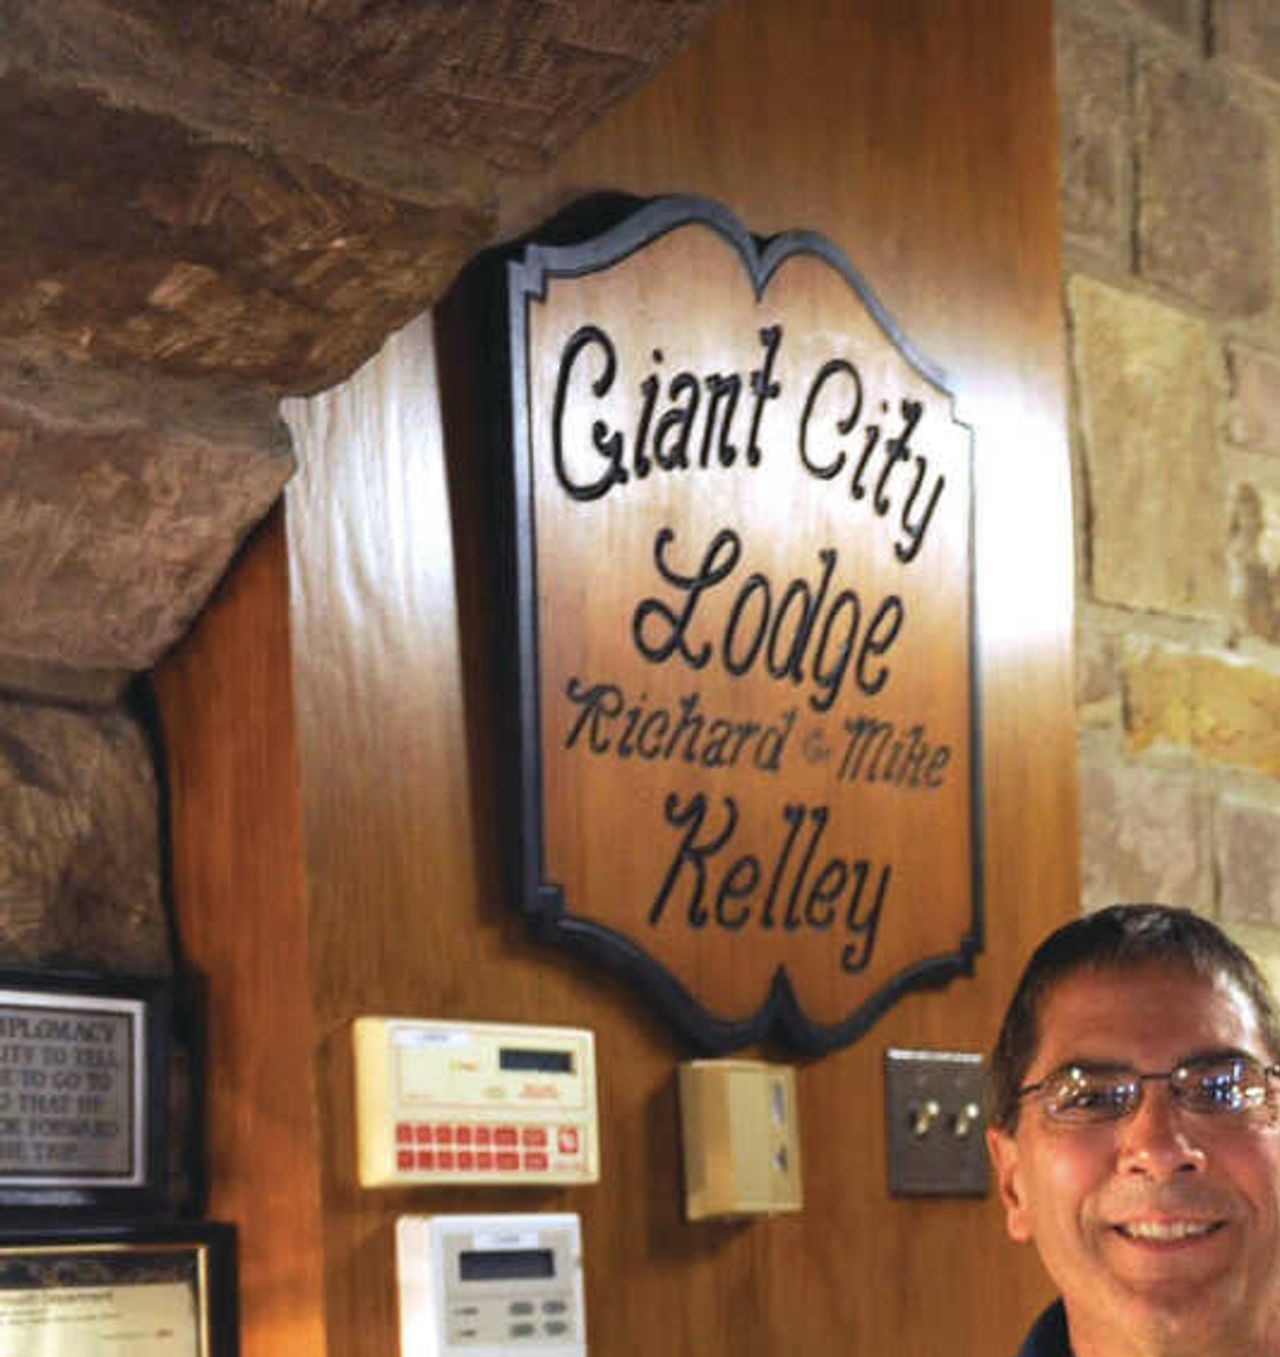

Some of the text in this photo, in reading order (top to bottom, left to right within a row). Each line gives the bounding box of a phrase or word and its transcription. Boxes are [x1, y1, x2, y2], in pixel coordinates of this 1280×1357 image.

[552, 324, 946, 564] Giant City
[632, 527, 905, 713] Lodge
[564, 677, 798, 773] Richard
[836, 714, 952, 789] Mike
[647, 792, 893, 975] Kelley
